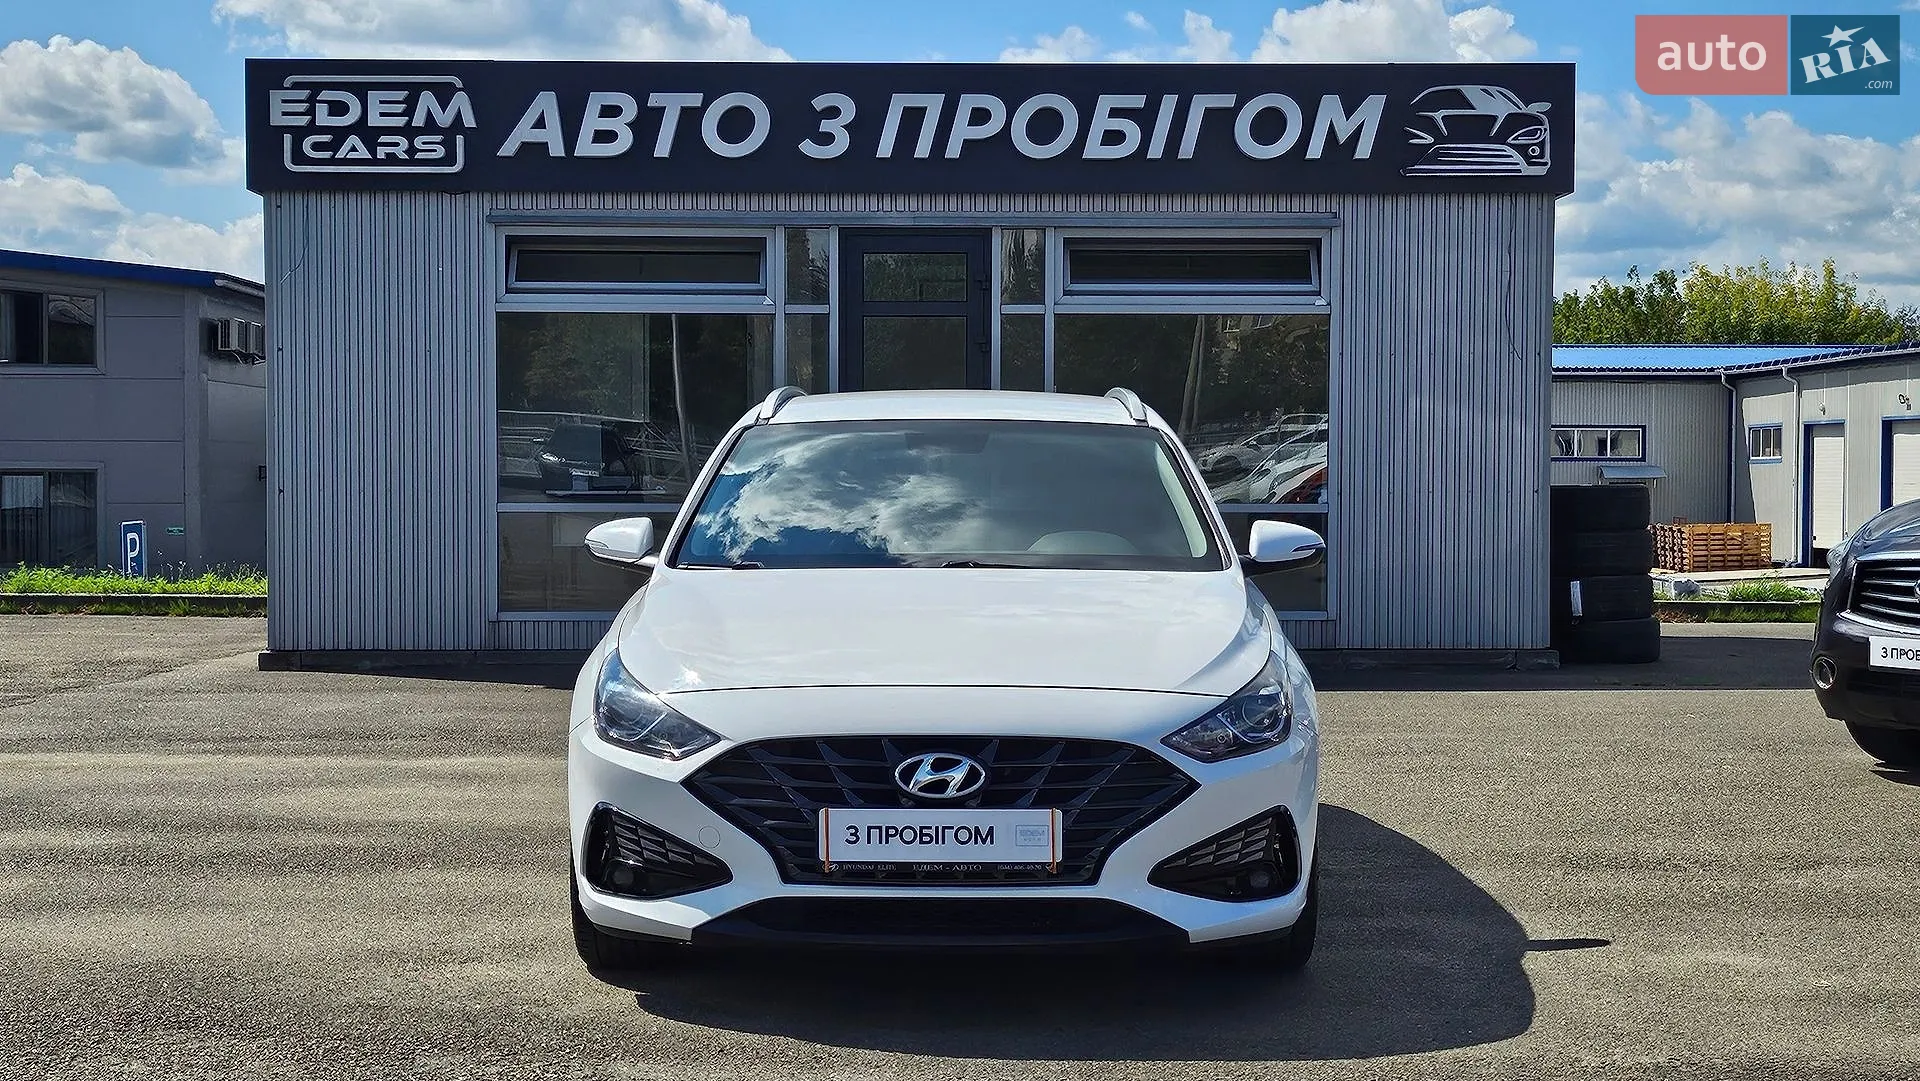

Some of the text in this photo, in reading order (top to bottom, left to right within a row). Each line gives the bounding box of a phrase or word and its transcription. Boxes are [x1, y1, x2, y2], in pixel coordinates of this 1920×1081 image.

[269, 89, 477, 129] EDEM
[496, 91, 1387, 160] АВТО З ПРОБІГОМ
[302, 134, 447, 159] CARS
[127, 532, 140, 574] P
[845, 825, 994, 845] З ПРОБІГОМ
